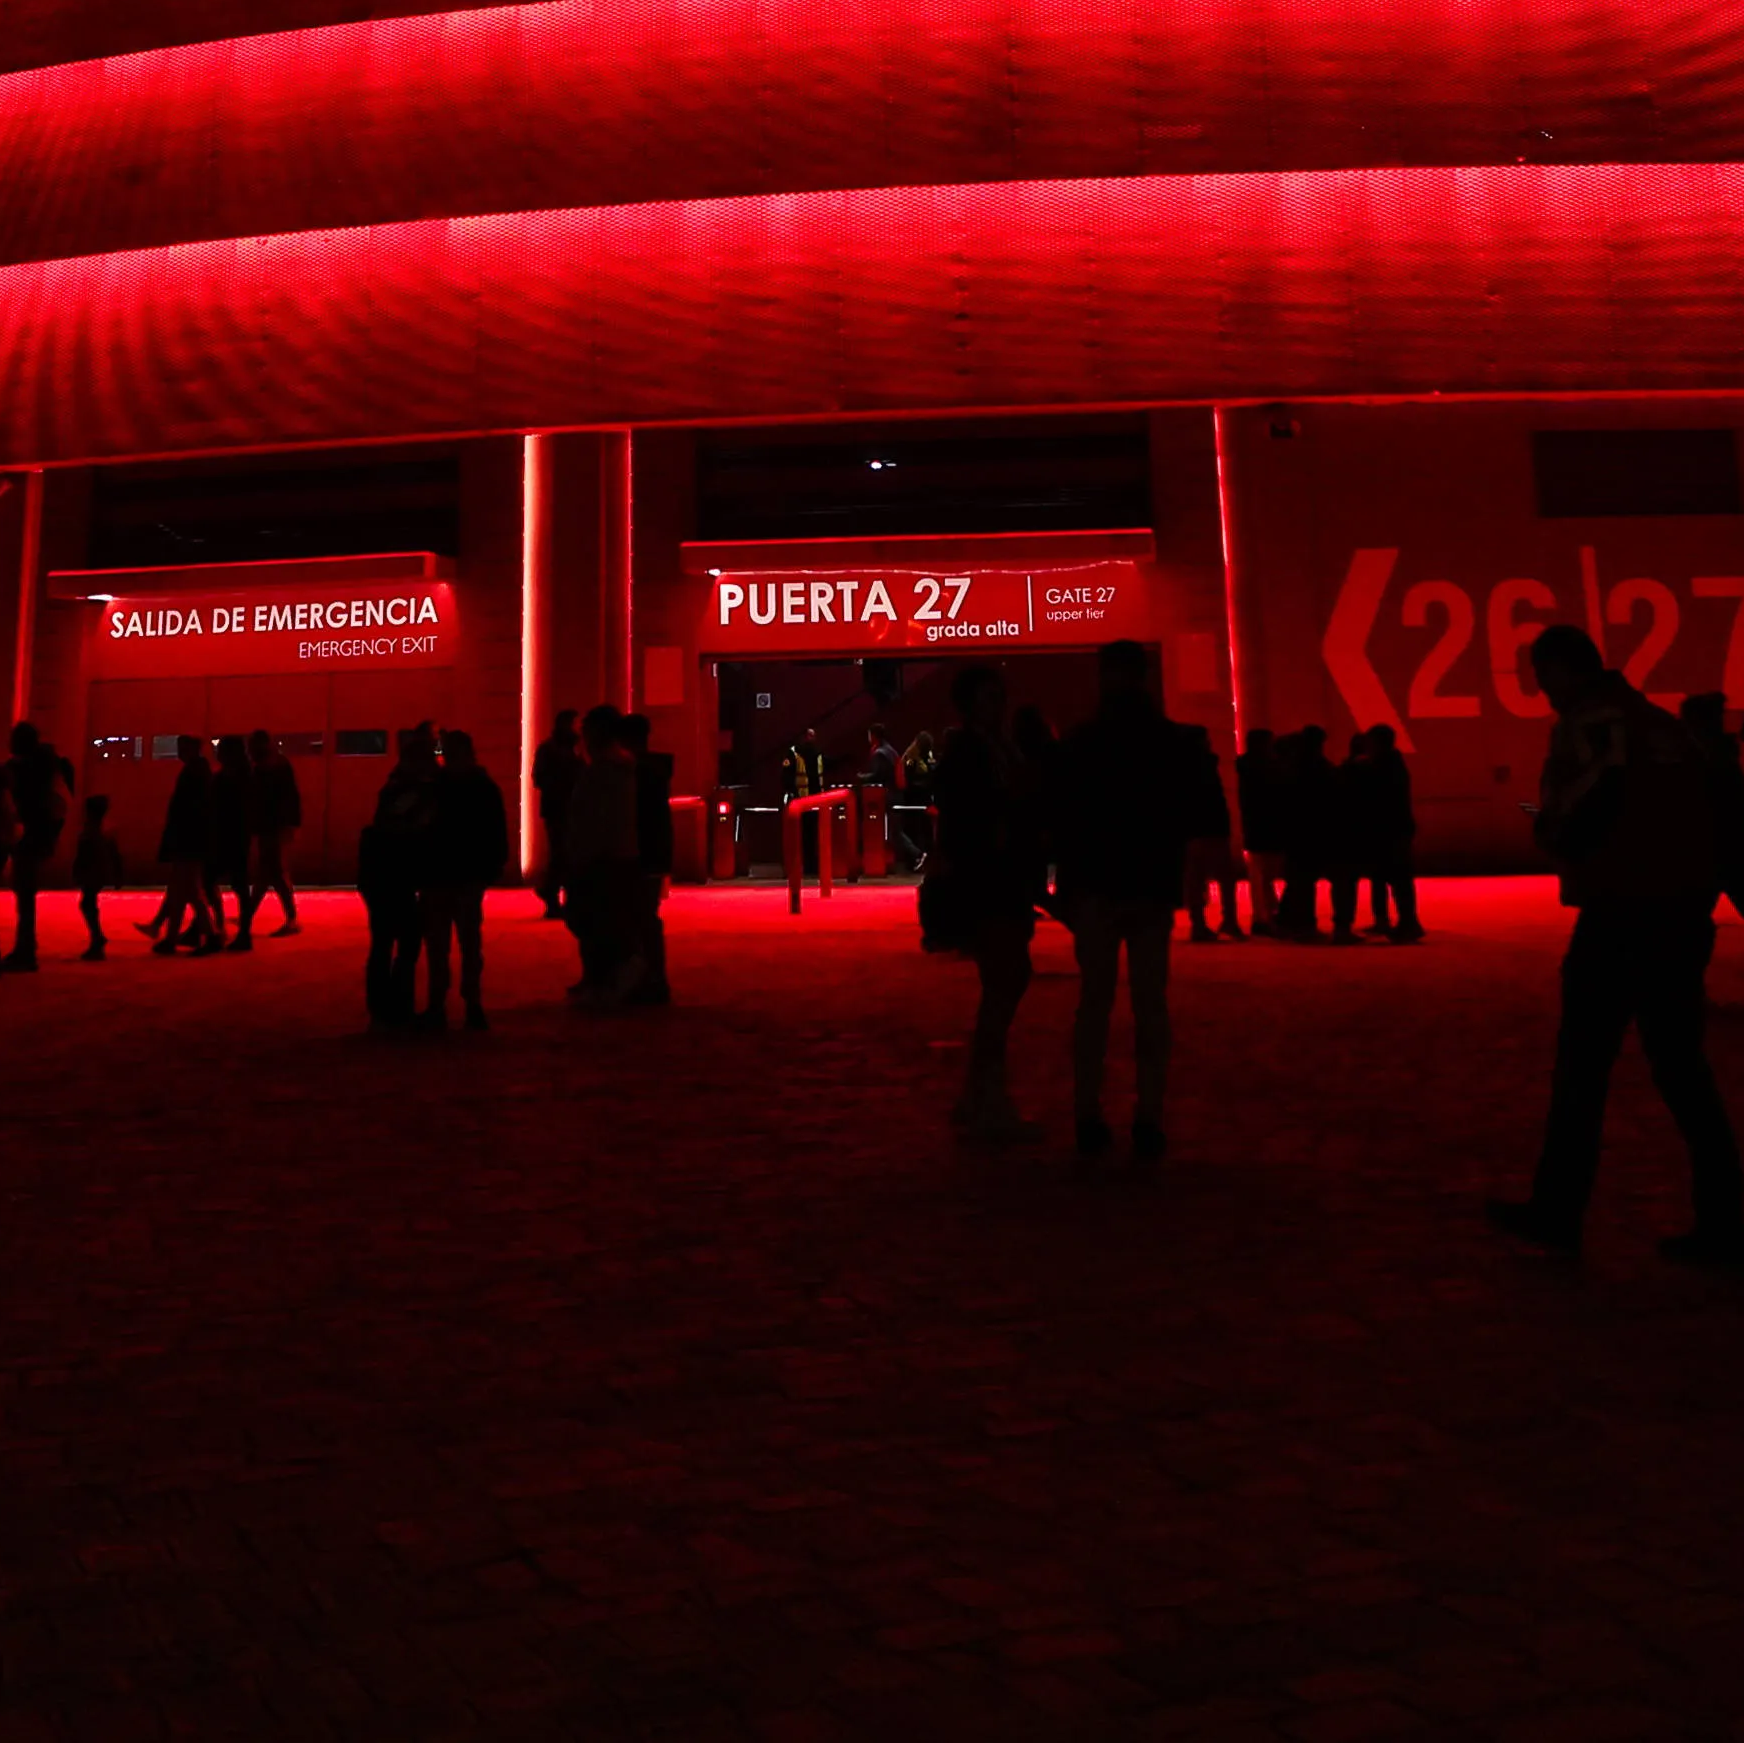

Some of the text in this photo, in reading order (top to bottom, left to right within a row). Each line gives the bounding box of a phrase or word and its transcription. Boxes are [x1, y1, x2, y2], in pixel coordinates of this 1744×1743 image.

[719, 577, 971, 625] PUERTA 27
[1045, 586, 1116, 604] GATE 27
[110, 596, 439, 638] SALIDA DE EMERGENCIA
[1046, 608, 1105, 622] upper tier
[926, 620, 1020, 642] grada alta
[299, 635, 438, 659] EMERGENCY EXIT
[1401, 577, 1558, 719] 26
